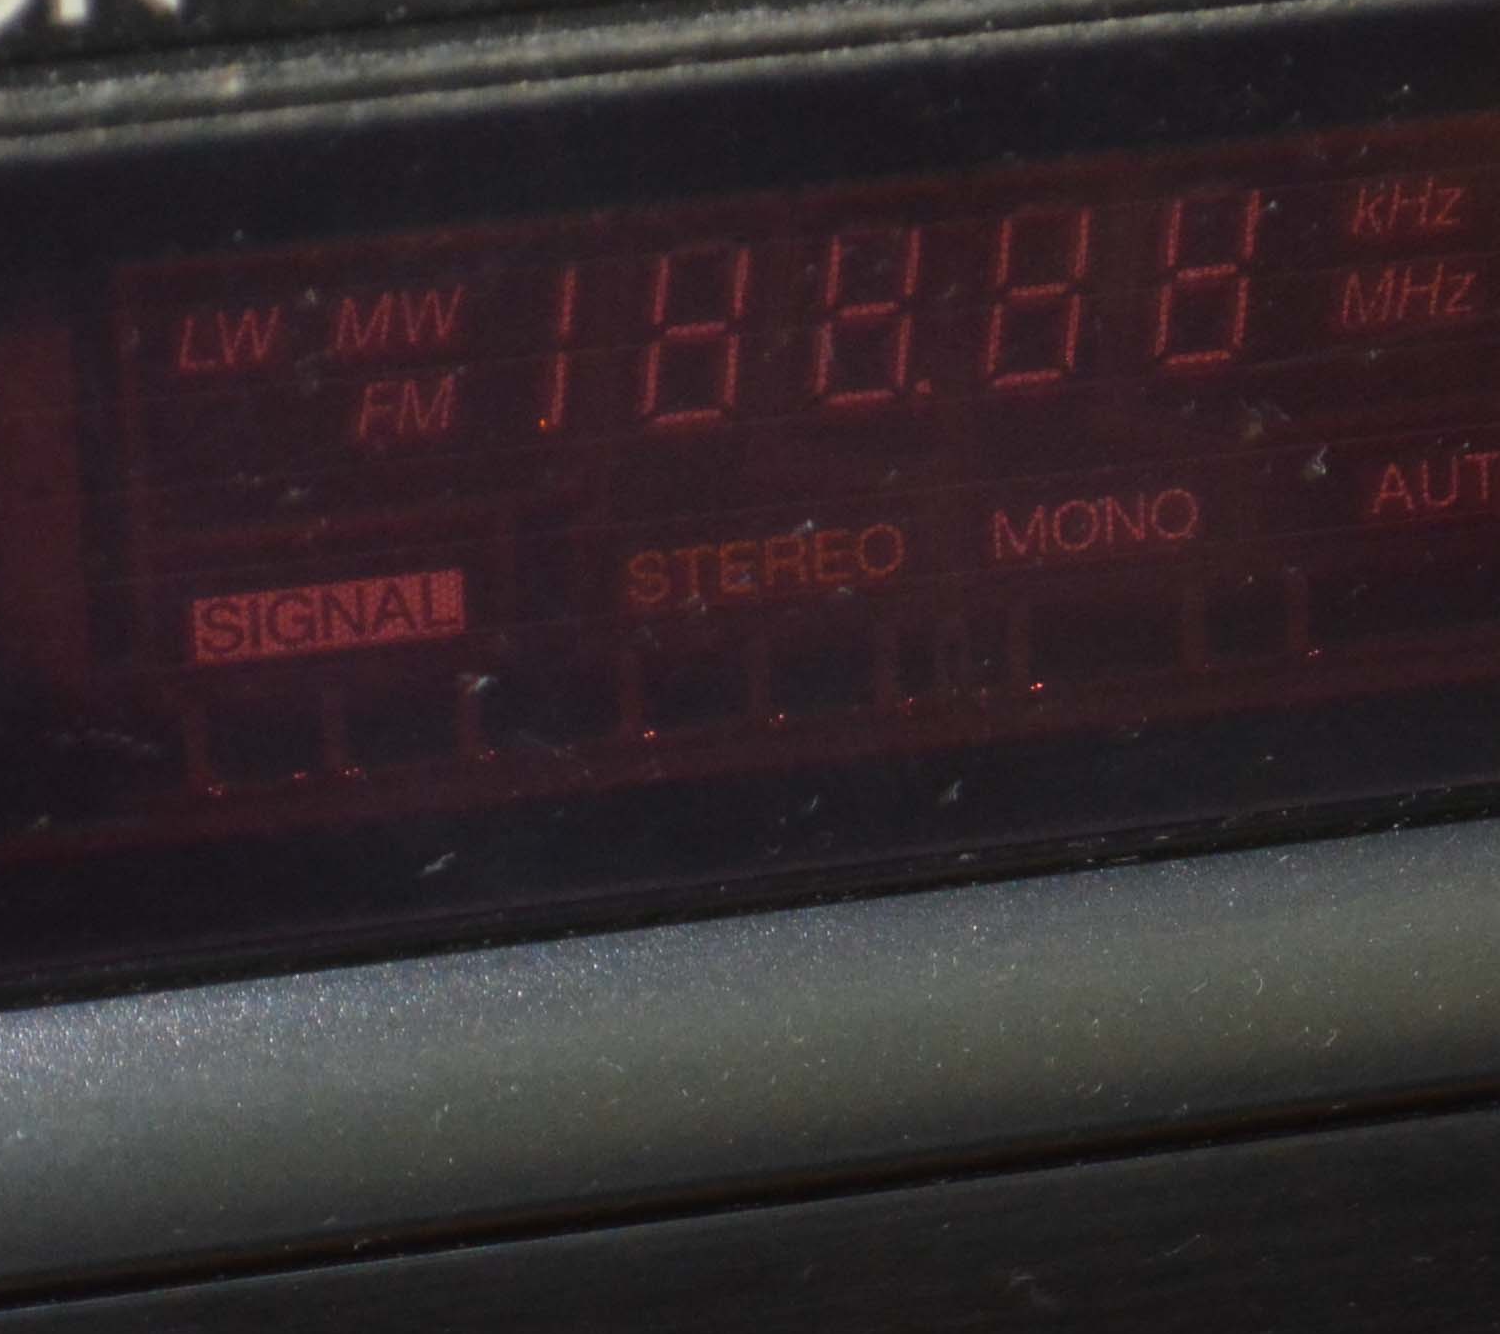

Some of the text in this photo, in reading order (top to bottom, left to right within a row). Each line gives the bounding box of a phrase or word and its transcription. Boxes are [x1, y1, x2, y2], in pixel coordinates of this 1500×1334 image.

[178, 285, 466, 371] LW MW
[1338, 265, 1476, 329] MHz
[358, 373, 460, 443] FM
[990, 487, 1200, 563] MONO
[624, 523, 902, 609] STEREO
[194, 569, 466, 663] SIGNAL
